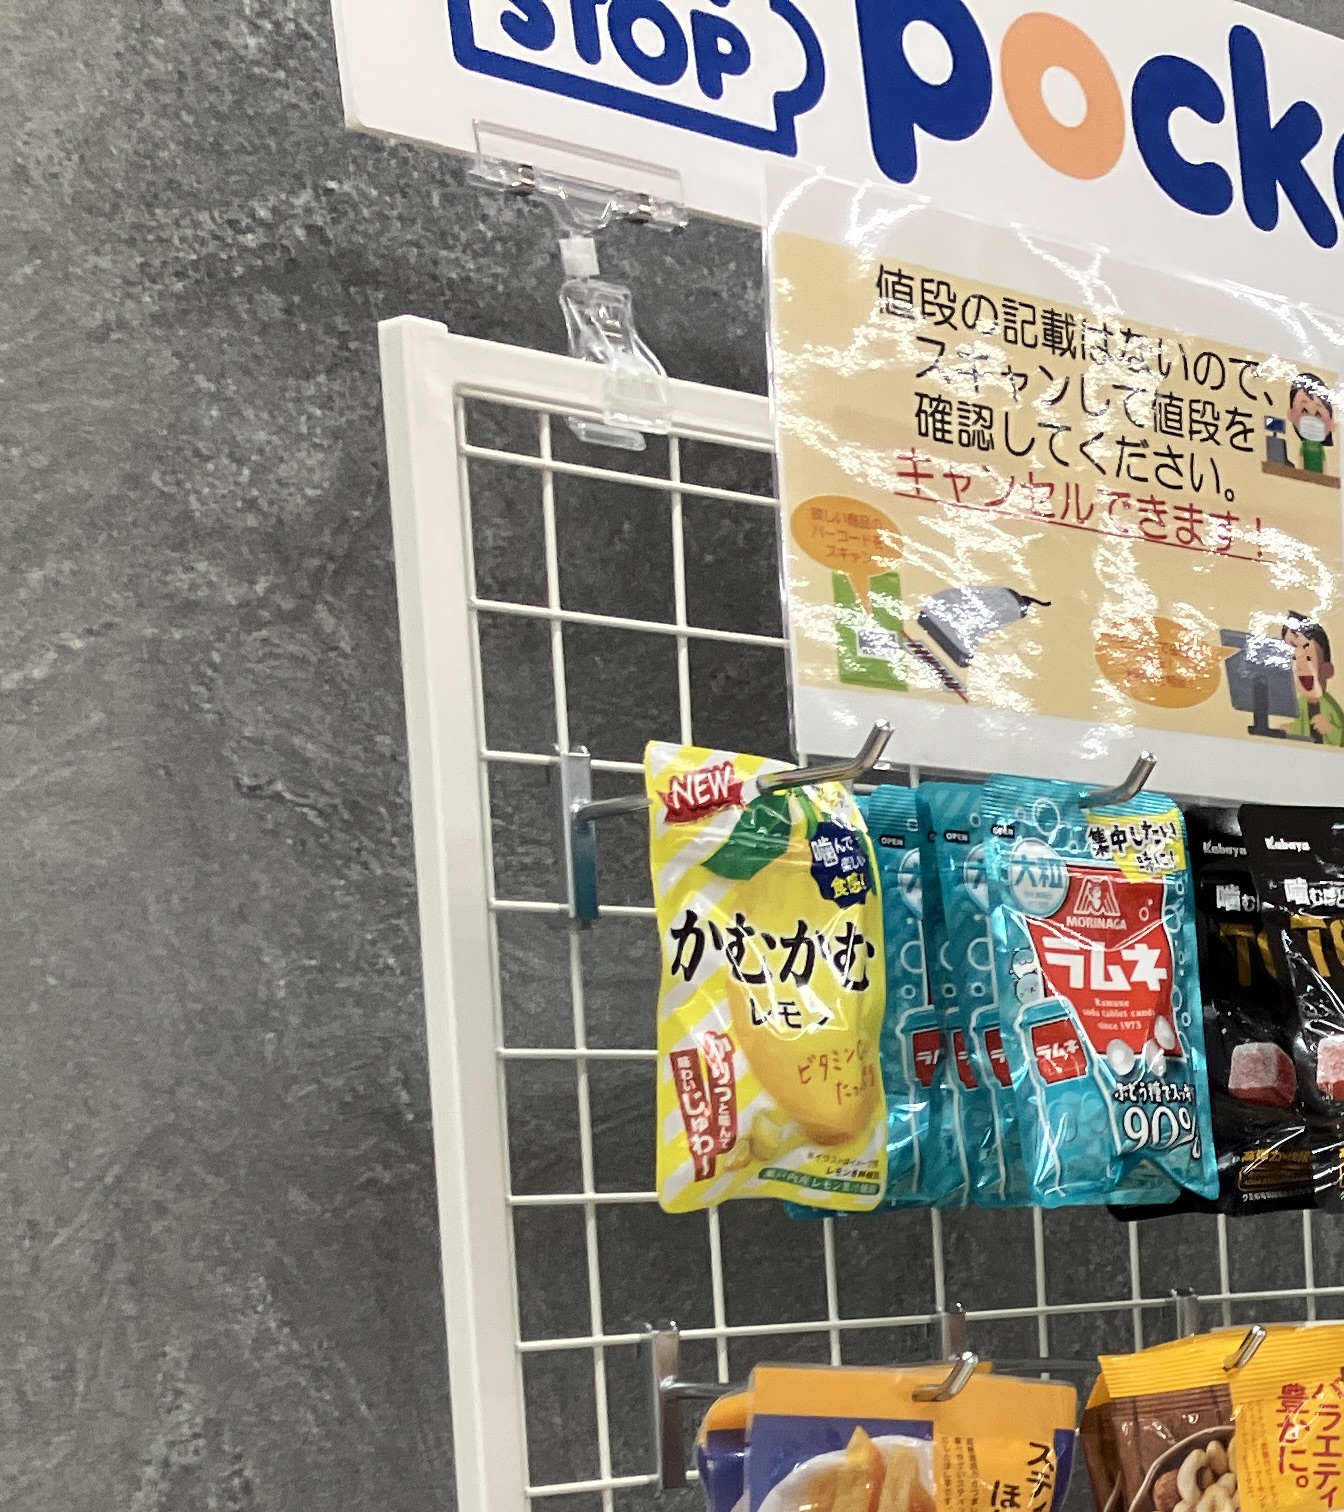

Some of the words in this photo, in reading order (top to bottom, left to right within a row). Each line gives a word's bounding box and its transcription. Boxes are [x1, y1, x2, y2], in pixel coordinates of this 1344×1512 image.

[876, 264, 1276, 406] 値段の記載はないので、
[915, 336, 1255, 454] スキャンして値段を
[914, 391, 1236, 502] 確認してください。
[670, 767, 735, 811] NEW
[1088, 820, 1177, 858] 集中したい
[1202, 840, 1248, 858] Kabaya
[1264, 835, 1311, 852] Kabaya
[669, 909, 876, 993] かむかむ
[1066, 916, 1127, 931] MORINAGA
[1041, 936, 1170, 992] ラムネ
[1275, 1382, 1312, 1489] 豊かに。
